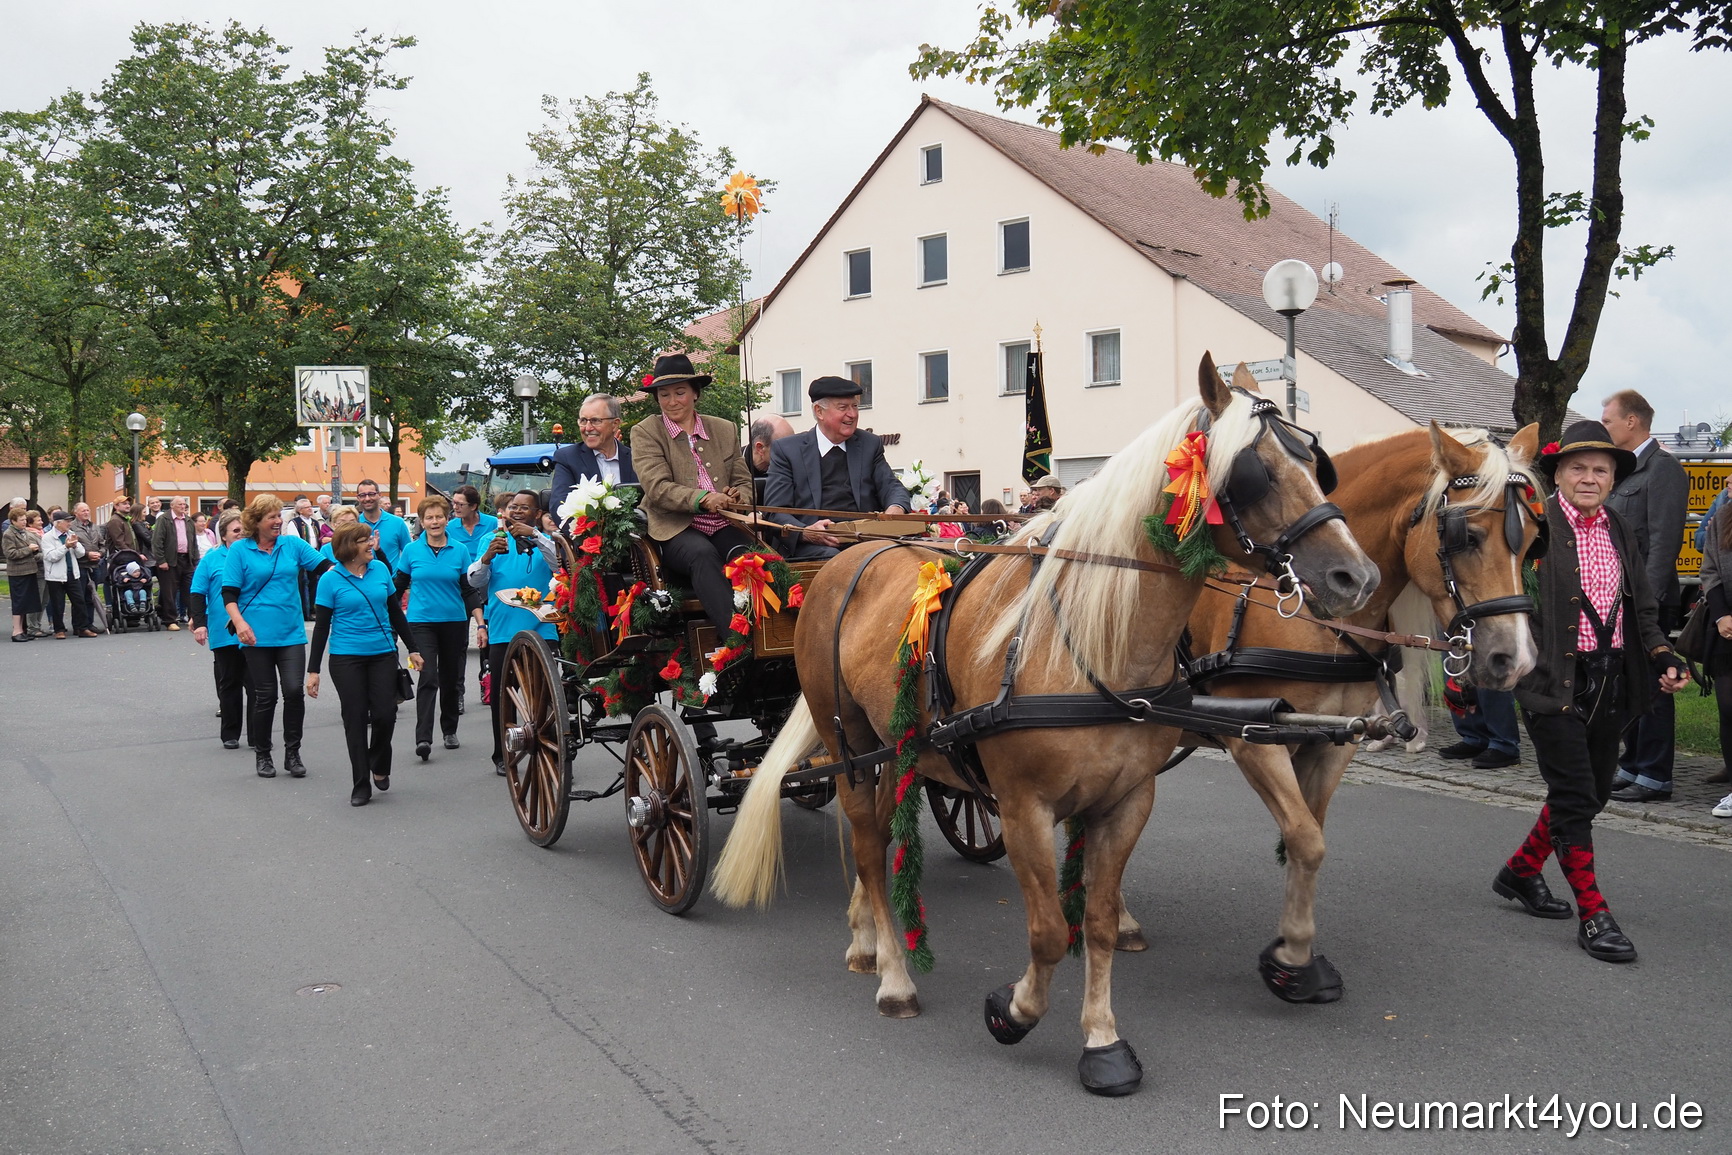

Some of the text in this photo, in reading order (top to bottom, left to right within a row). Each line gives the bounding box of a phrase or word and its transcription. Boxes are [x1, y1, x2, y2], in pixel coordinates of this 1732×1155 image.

[1688, 470, 1728, 491] hofen
[1689, 494, 1706, 506] cht
[1677, 556, 1702, 569] berg
